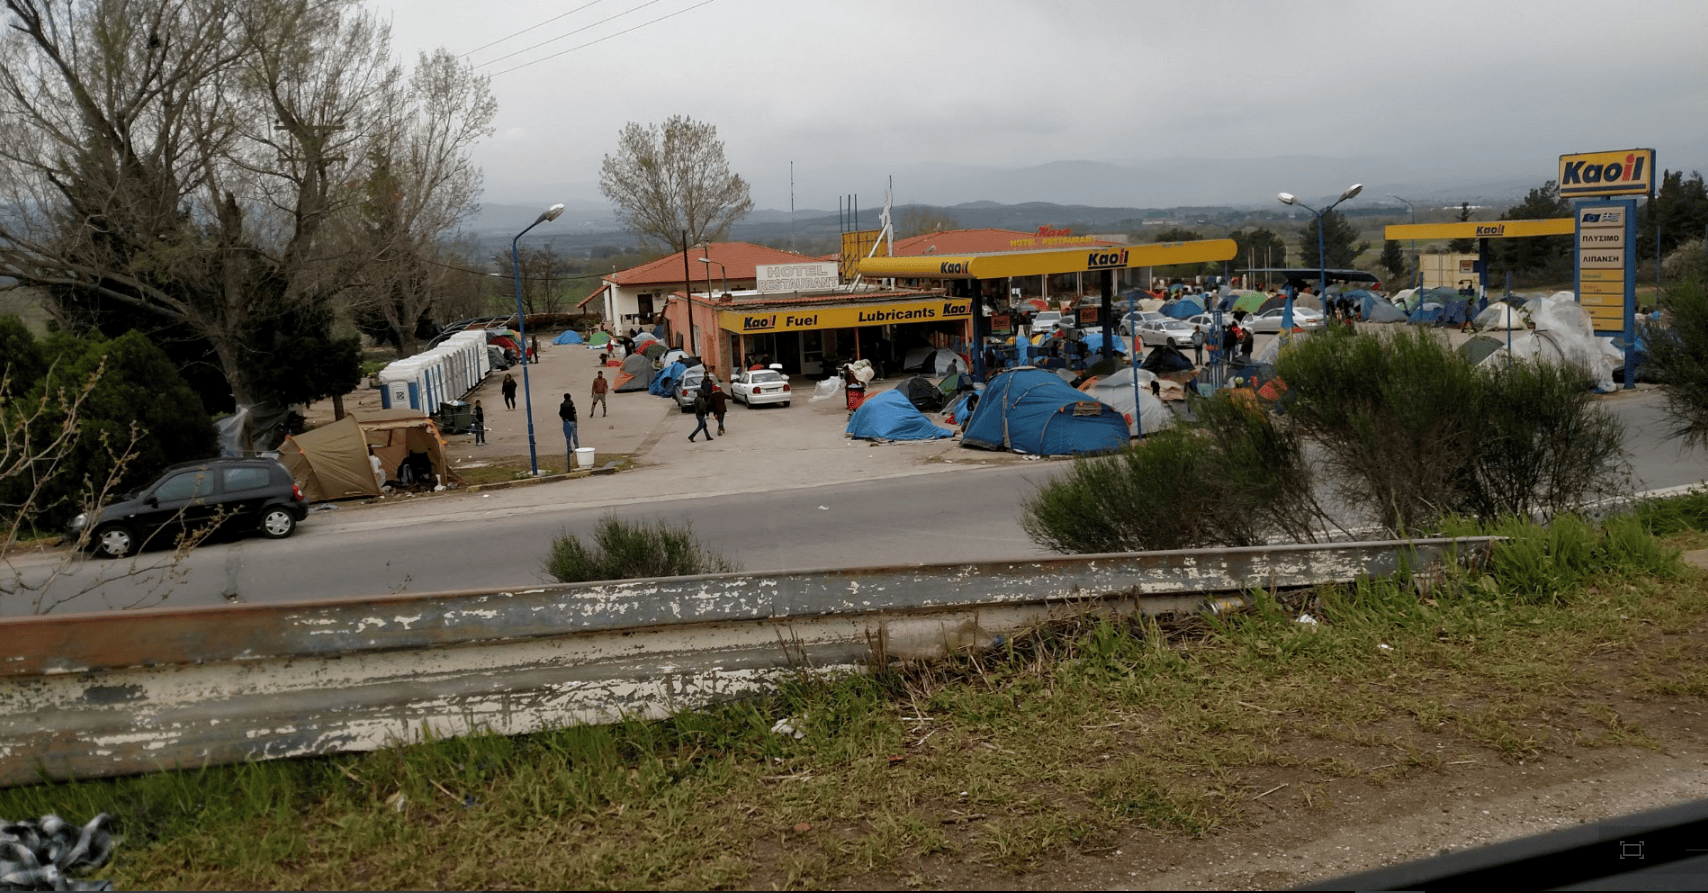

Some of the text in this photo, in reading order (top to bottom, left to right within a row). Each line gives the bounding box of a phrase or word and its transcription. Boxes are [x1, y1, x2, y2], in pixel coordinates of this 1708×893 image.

[1562, 154, 1645, 184] Kaoil
[1476, 224, 1505, 234] Kaoil
[1088, 248, 1129, 266] Kaoil
[767, 265, 828, 278] HOTEL
[940, 260, 969, 274] Kaoil
[758, 277, 838, 292] RESTAURANT
[744, 315, 776, 328] Kaoil
[786, 315, 817, 327] Fuel
[858, 308, 935, 323] Lubricants
